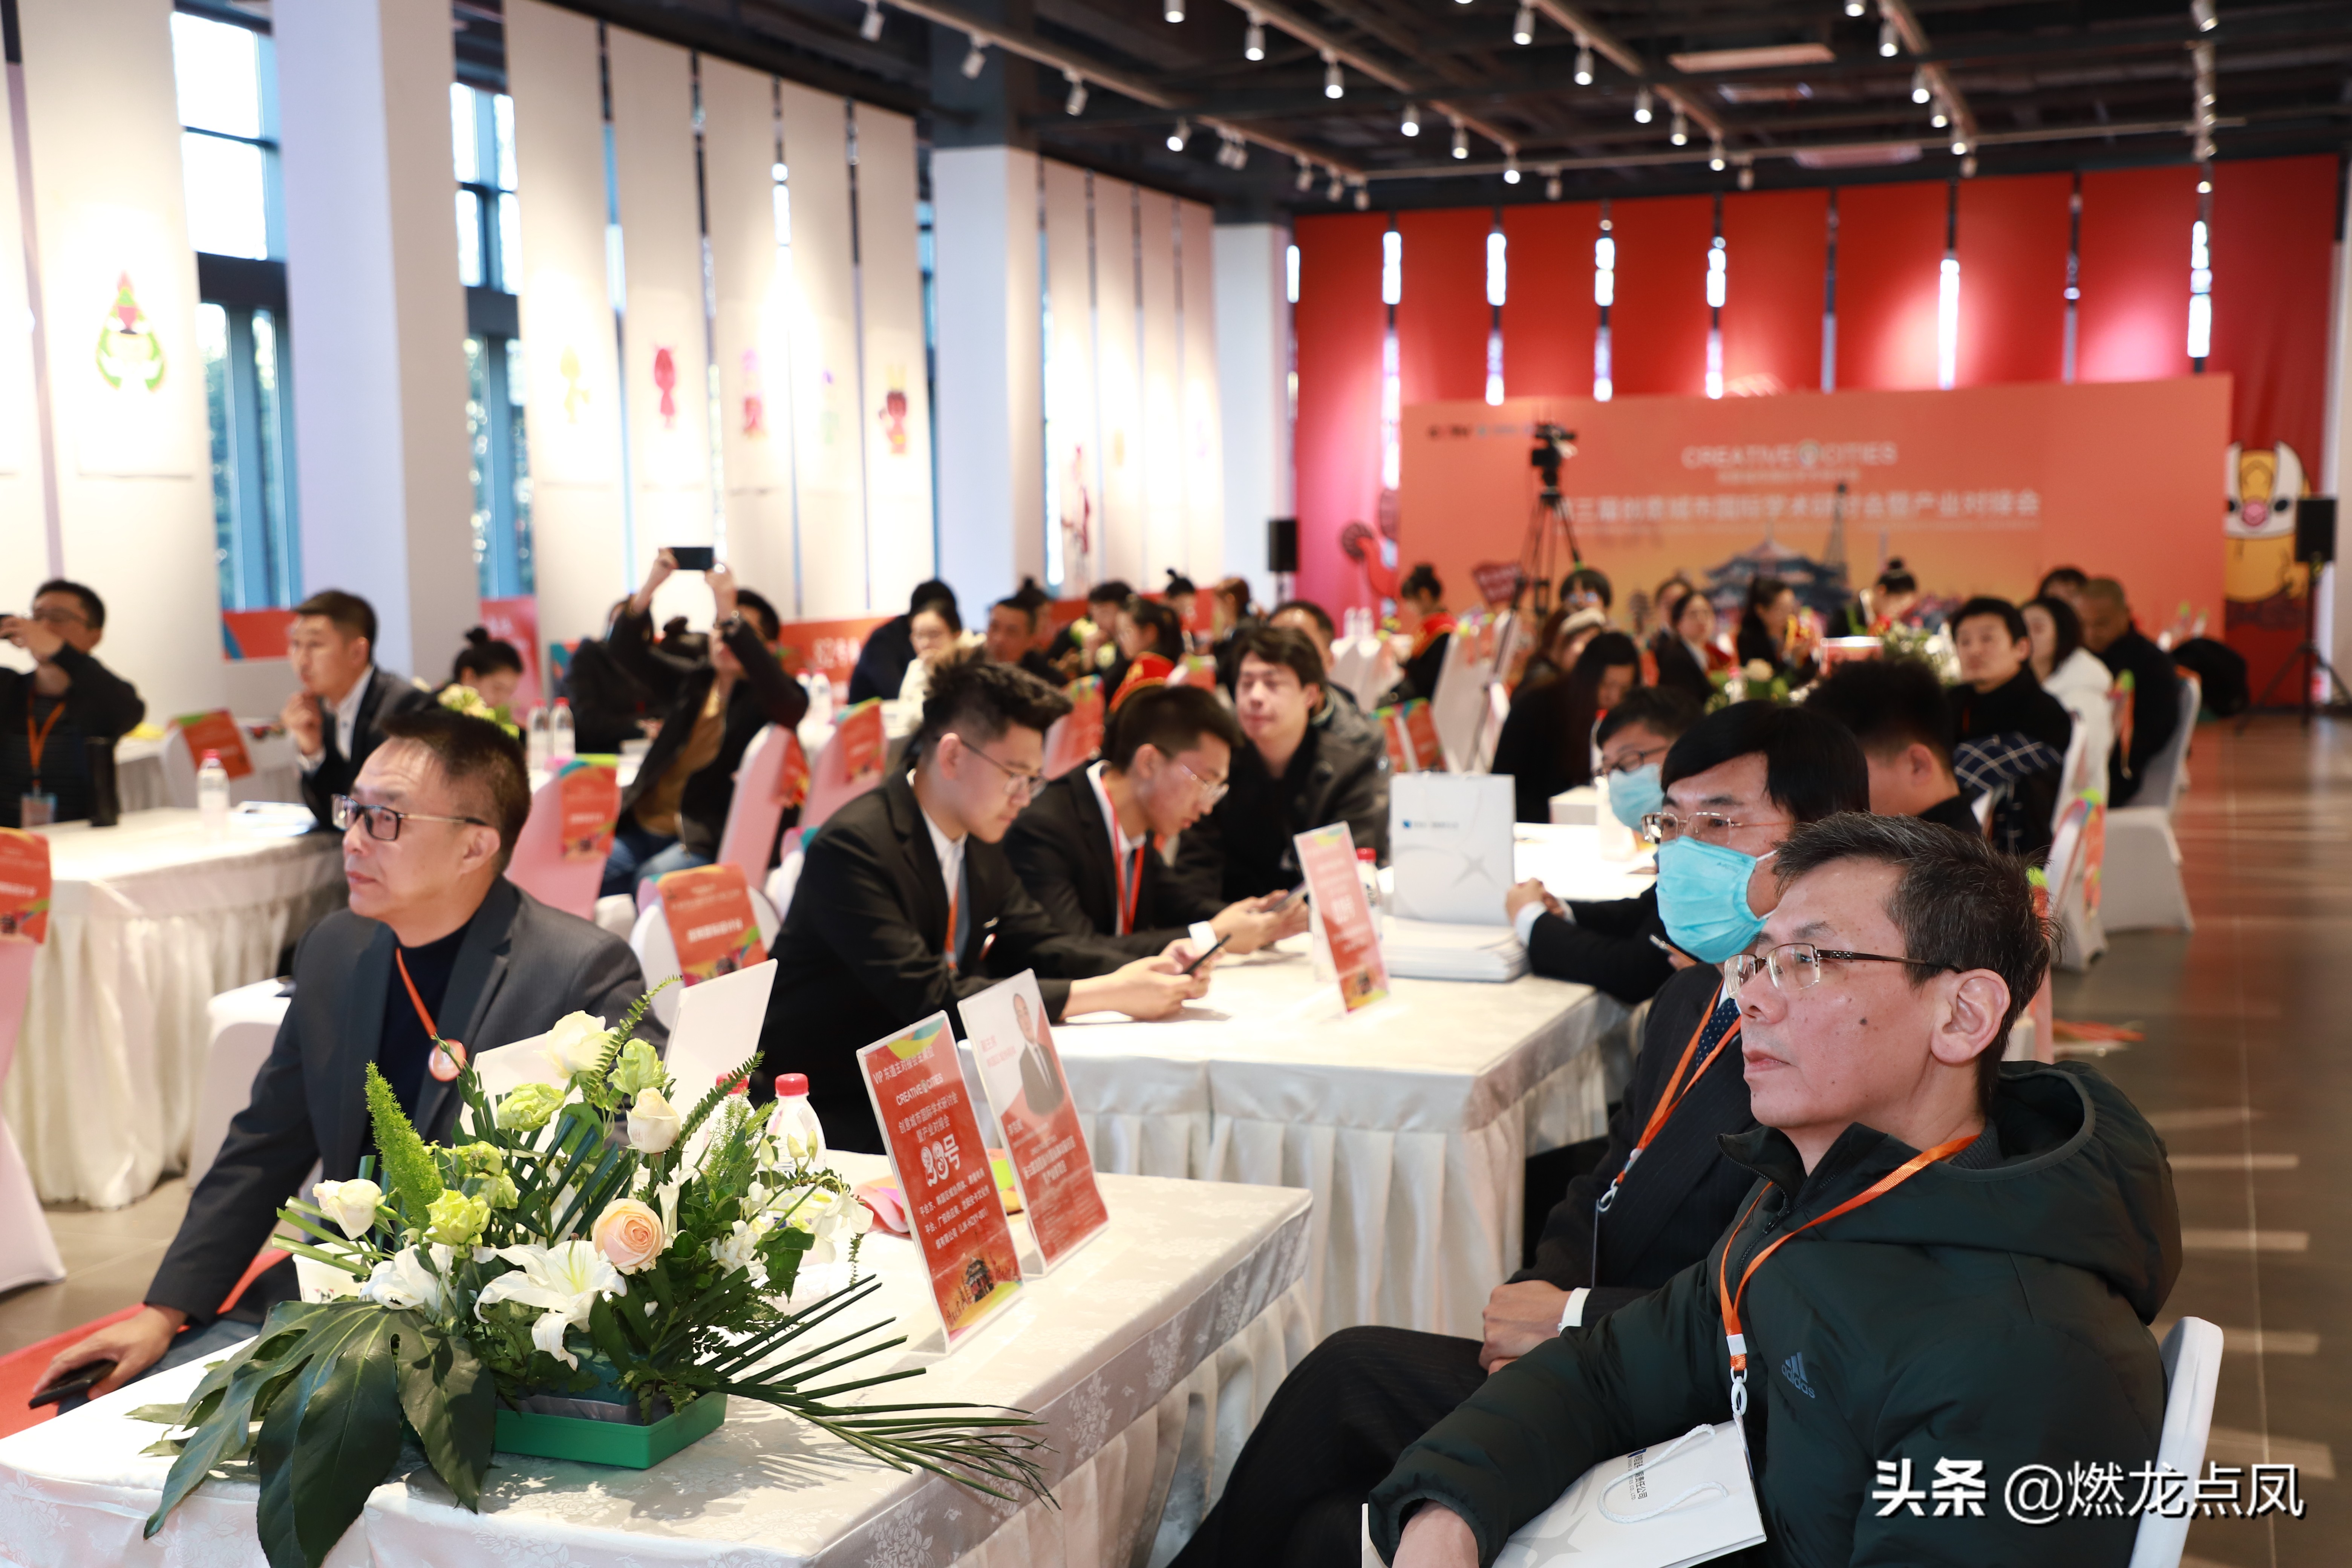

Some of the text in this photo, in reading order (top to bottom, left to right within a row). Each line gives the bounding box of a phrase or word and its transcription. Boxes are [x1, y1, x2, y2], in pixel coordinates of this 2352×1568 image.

[1681, 441, 1897, 469] CREATIVE CITIES
[873, 1071, 883, 1084] VIP
[896, 1073, 944, 1106] CREATIVE CITIES
[1781, 1364, 1815, 1398] adidas
